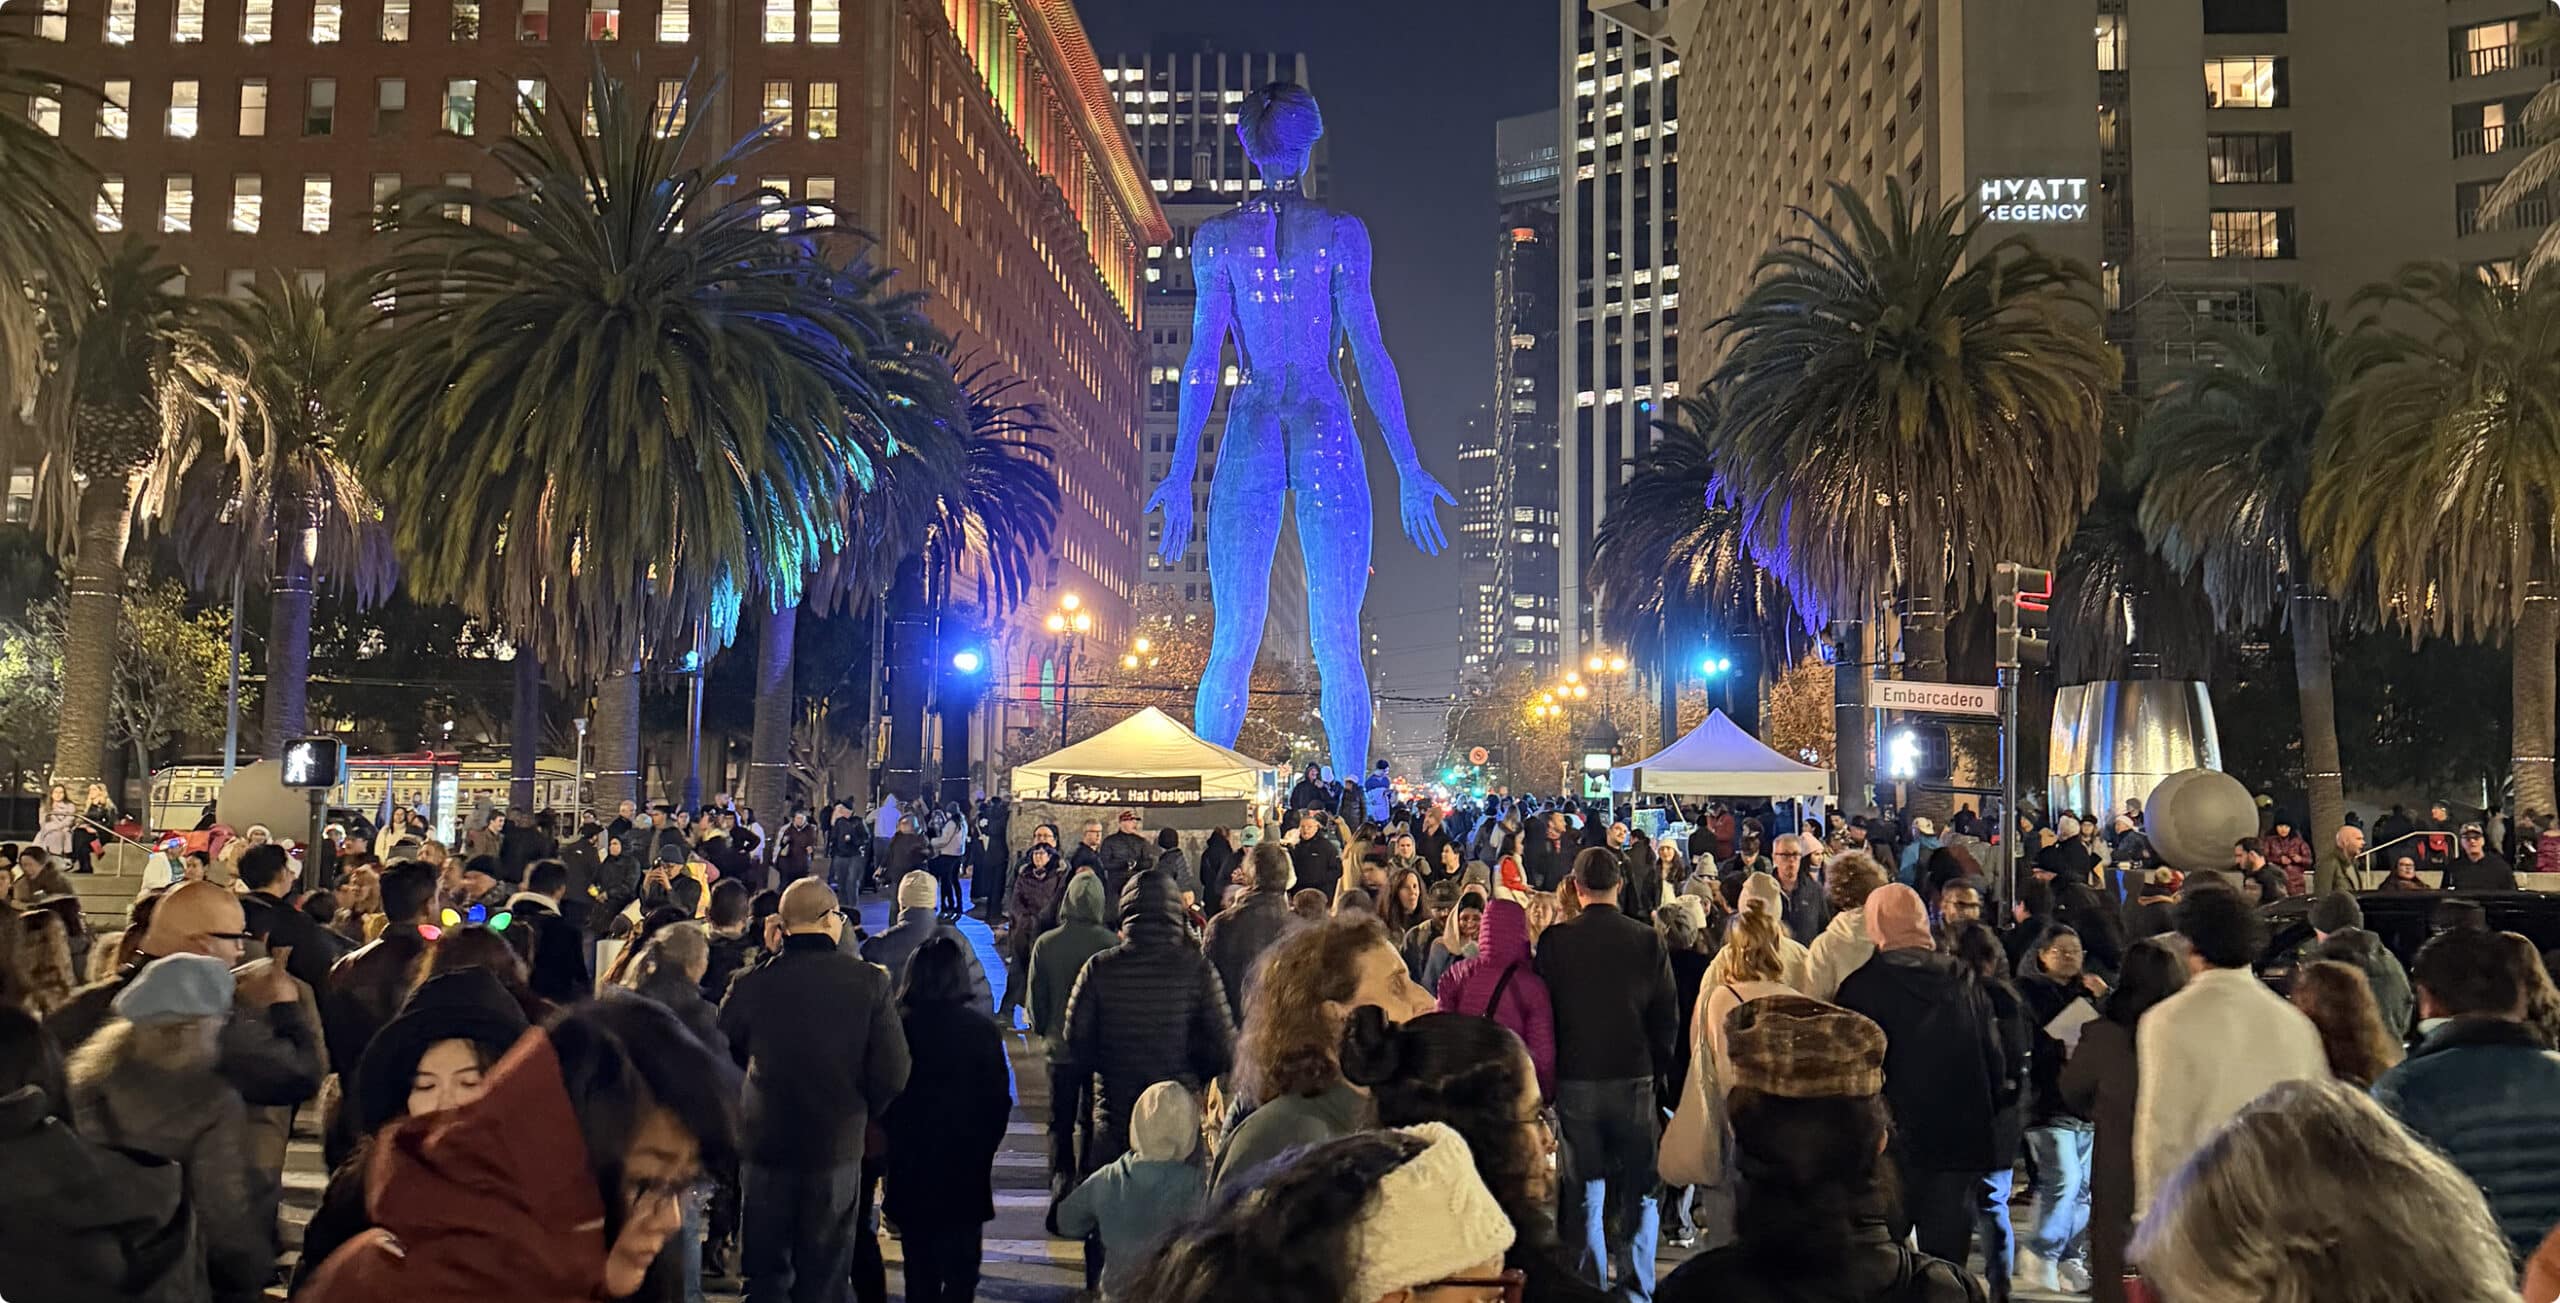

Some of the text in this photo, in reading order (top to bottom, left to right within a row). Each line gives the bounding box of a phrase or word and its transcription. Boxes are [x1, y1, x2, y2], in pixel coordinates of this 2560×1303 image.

[1982, 179, 2087, 201] HYATT
[1883, 687, 1984, 708] Embarcadero
[1128, 789, 1149, 802] Hat
[1152, 788, 1200, 803] Designs
